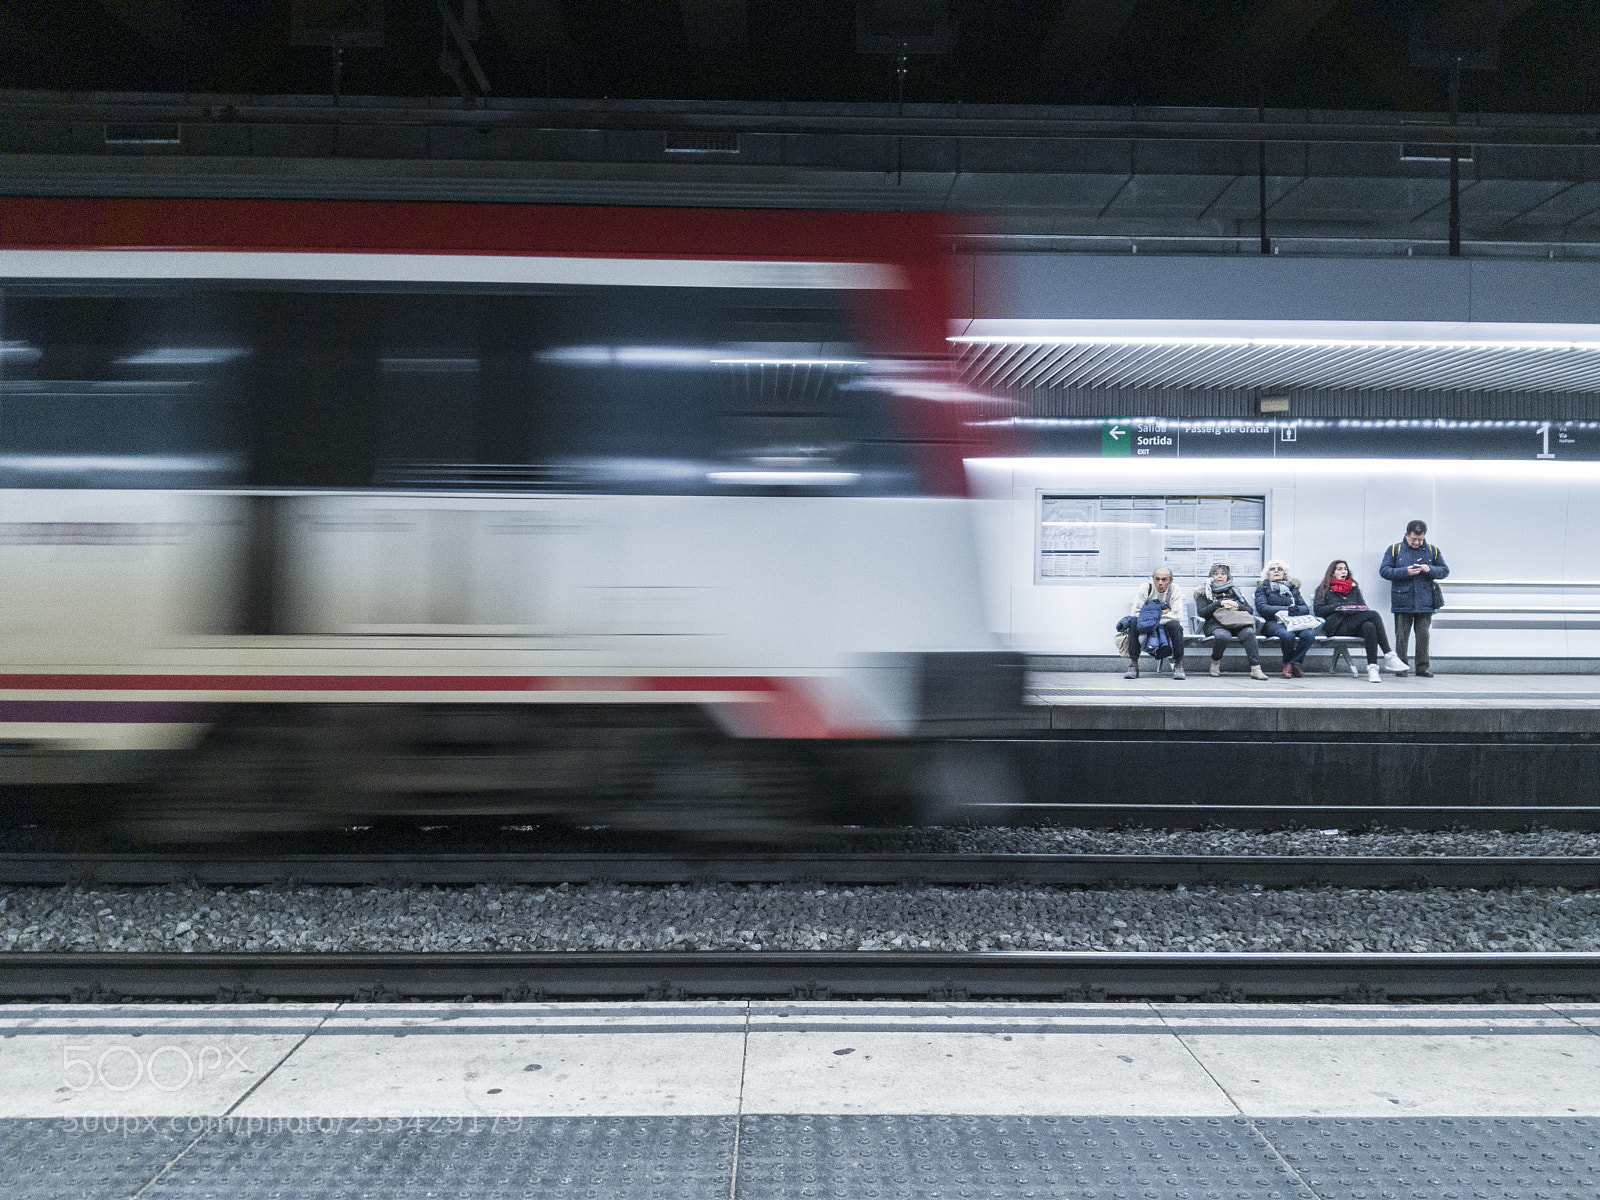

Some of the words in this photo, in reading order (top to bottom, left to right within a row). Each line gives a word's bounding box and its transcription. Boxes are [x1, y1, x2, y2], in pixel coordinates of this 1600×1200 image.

[1138, 422, 1167, 433] Salida
[1185, 423, 1221, 435] Passeig
[1224, 423, 1236, 433] de
[1137, 435, 1173, 446] Sortida
[1536, 423, 1555, 459] 1
